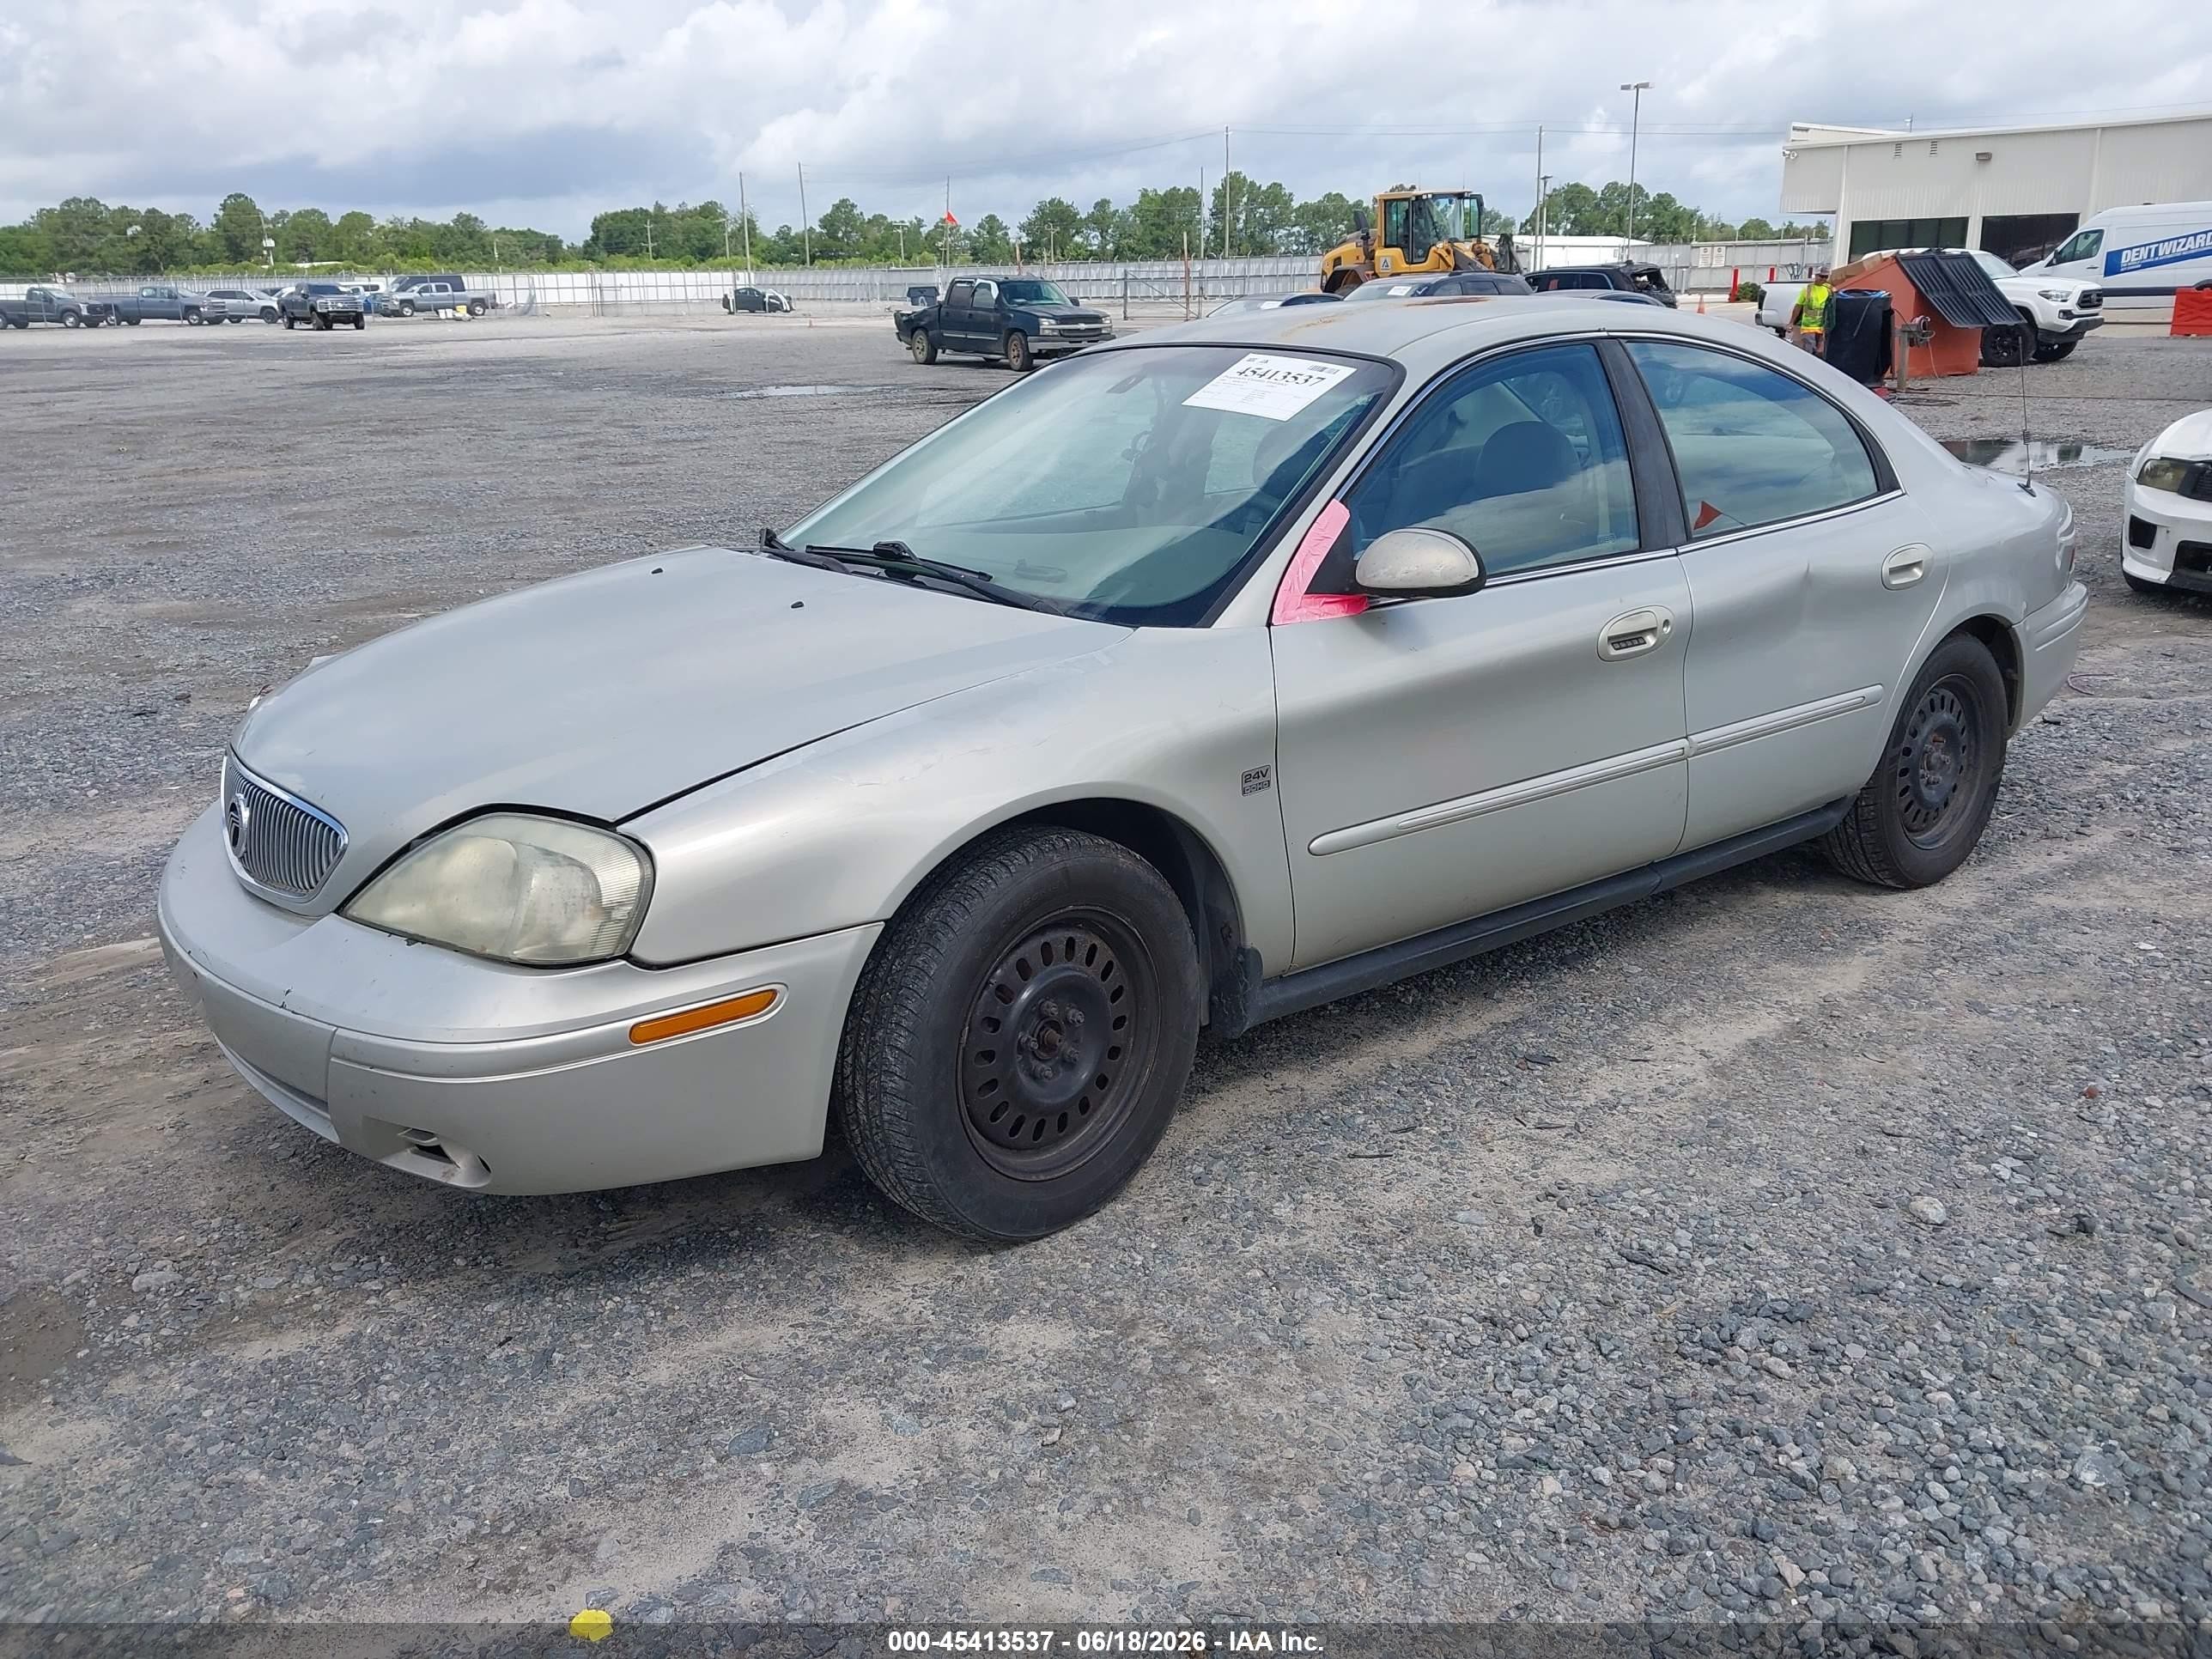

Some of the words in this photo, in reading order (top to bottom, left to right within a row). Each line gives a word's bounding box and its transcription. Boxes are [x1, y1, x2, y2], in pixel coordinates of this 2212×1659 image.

[2121, 243, 2159, 264] DENT
[1237, 367, 1326, 386] 45413537
[1244, 768, 1269, 783] 24V
